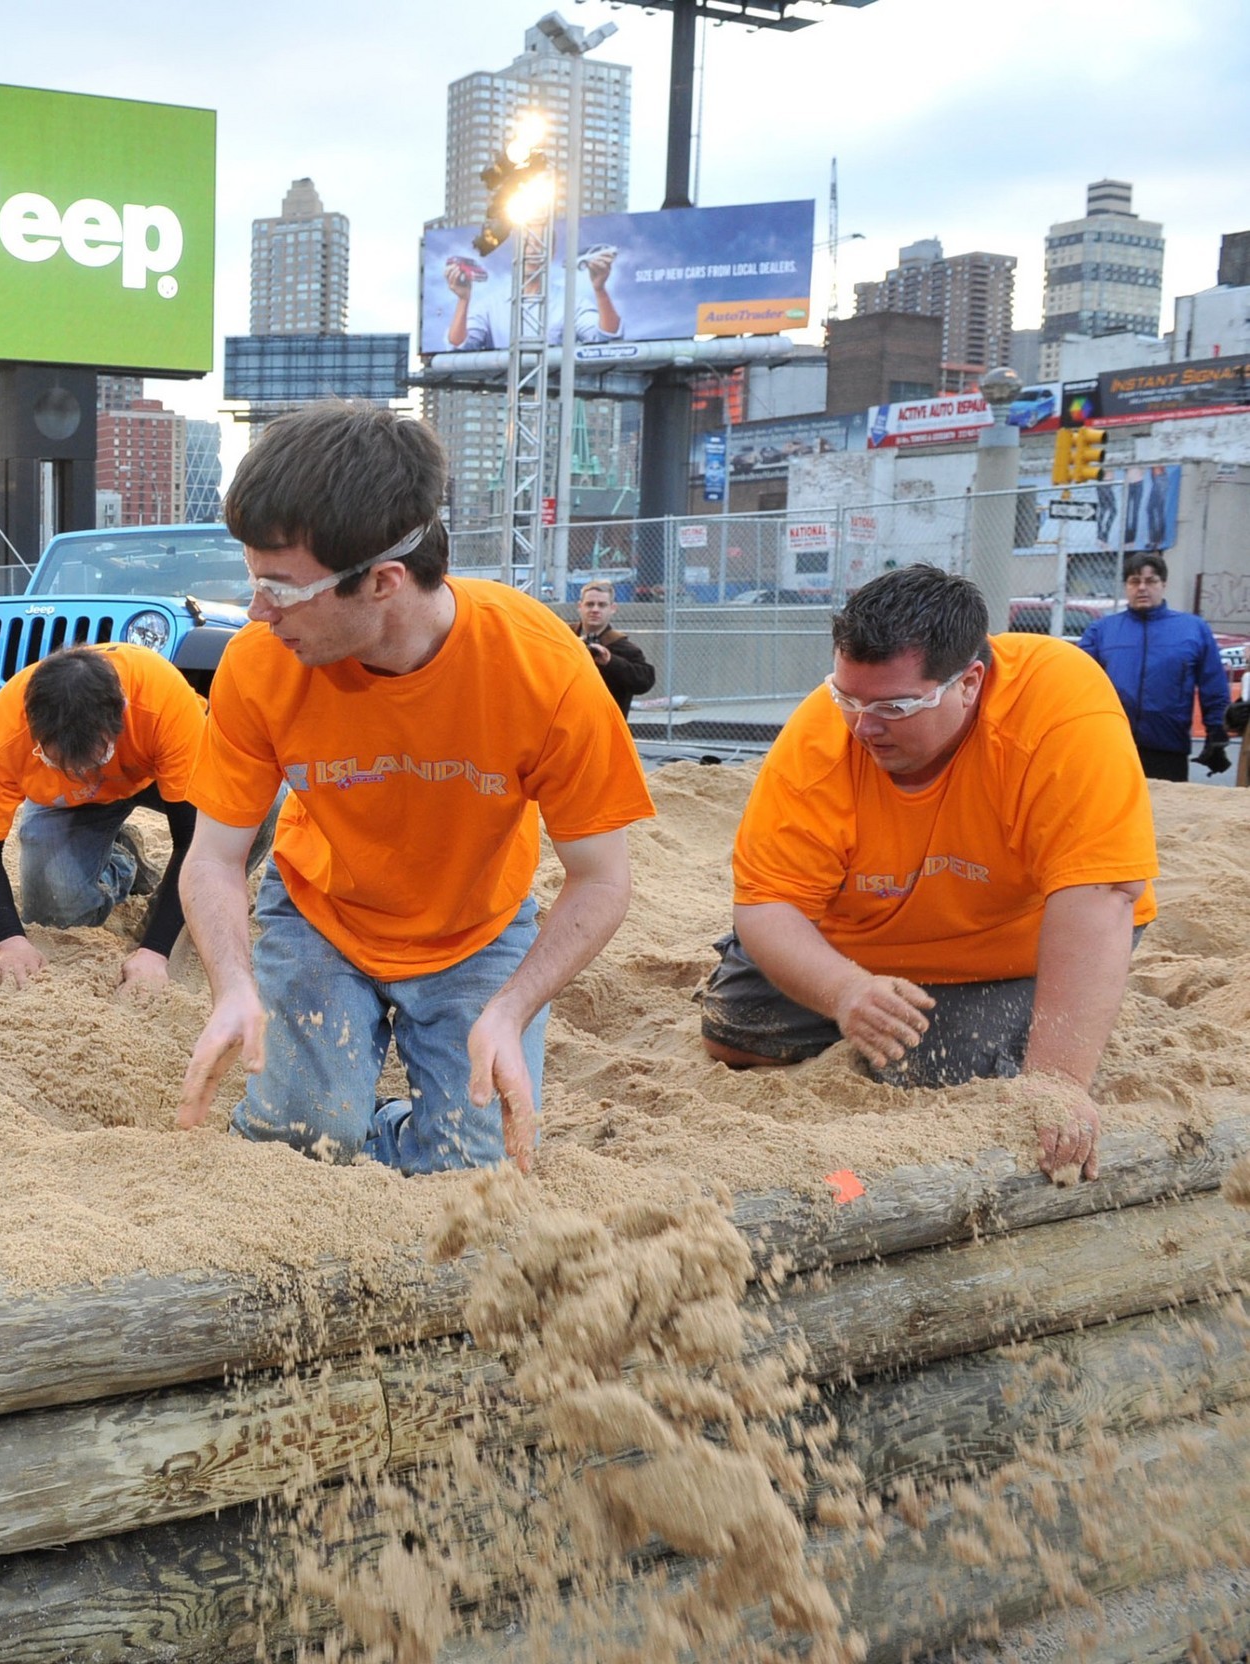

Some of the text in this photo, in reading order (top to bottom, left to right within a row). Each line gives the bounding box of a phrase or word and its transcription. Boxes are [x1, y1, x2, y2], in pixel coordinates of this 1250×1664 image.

[635, 270, 653, 282] SIZE
[654, 269, 665, 281] UP
[665, 268, 684, 280] NEW
[685, 266, 707, 279] CARS
[707, 264, 731, 278] FROM
[732, 262, 758, 276] LOCAL
[1110, 373, 1178, 393] INSTANT
[898, 405, 927, 421] ACTIVE
[930, 403, 954, 418] AUTO
[790, 525, 827, 538] NATIONAL
[25, 605, 55, 616] Jeep
[314, 754, 508, 796] ISLANDER
